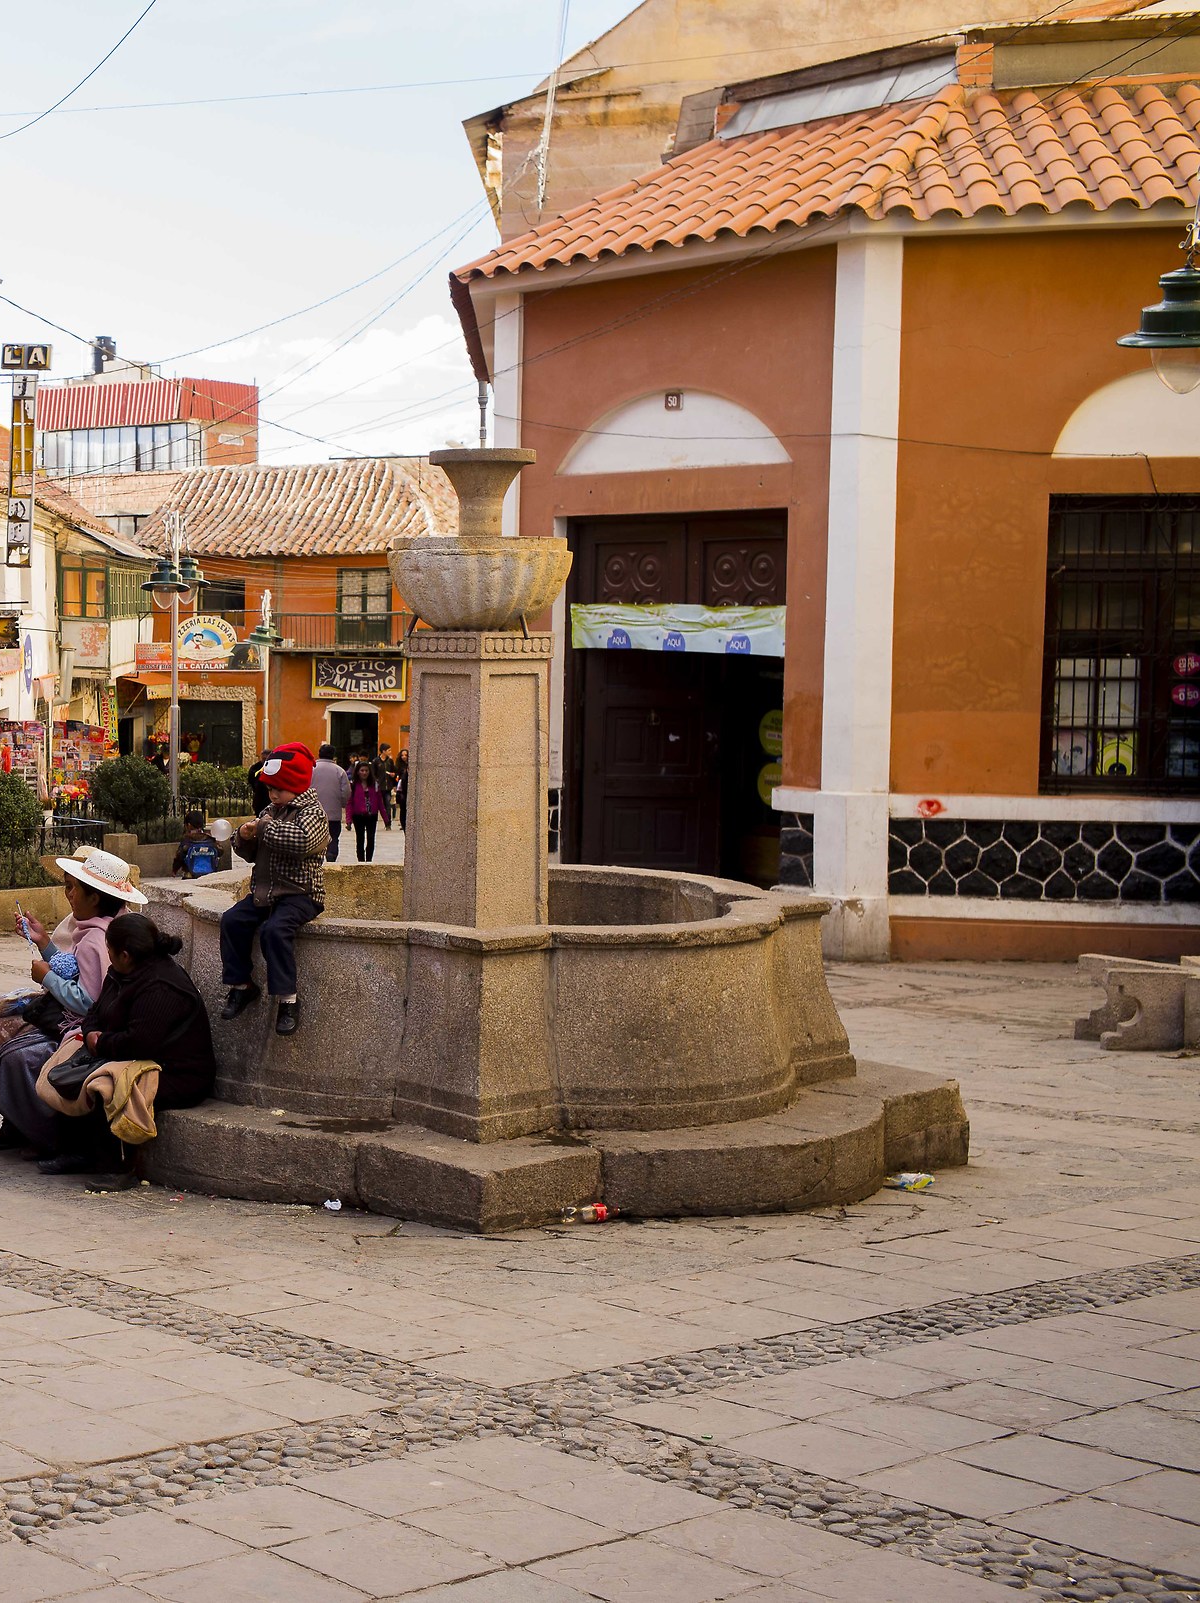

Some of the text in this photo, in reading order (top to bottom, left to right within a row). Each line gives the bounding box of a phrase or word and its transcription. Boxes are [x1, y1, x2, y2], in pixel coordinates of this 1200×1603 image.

[3, 346, 46, 365] LA
[203, 617, 216, 625] LAS
[335, 660, 397, 676] OPTICA
[332, 674, 397, 693] MILENIO
